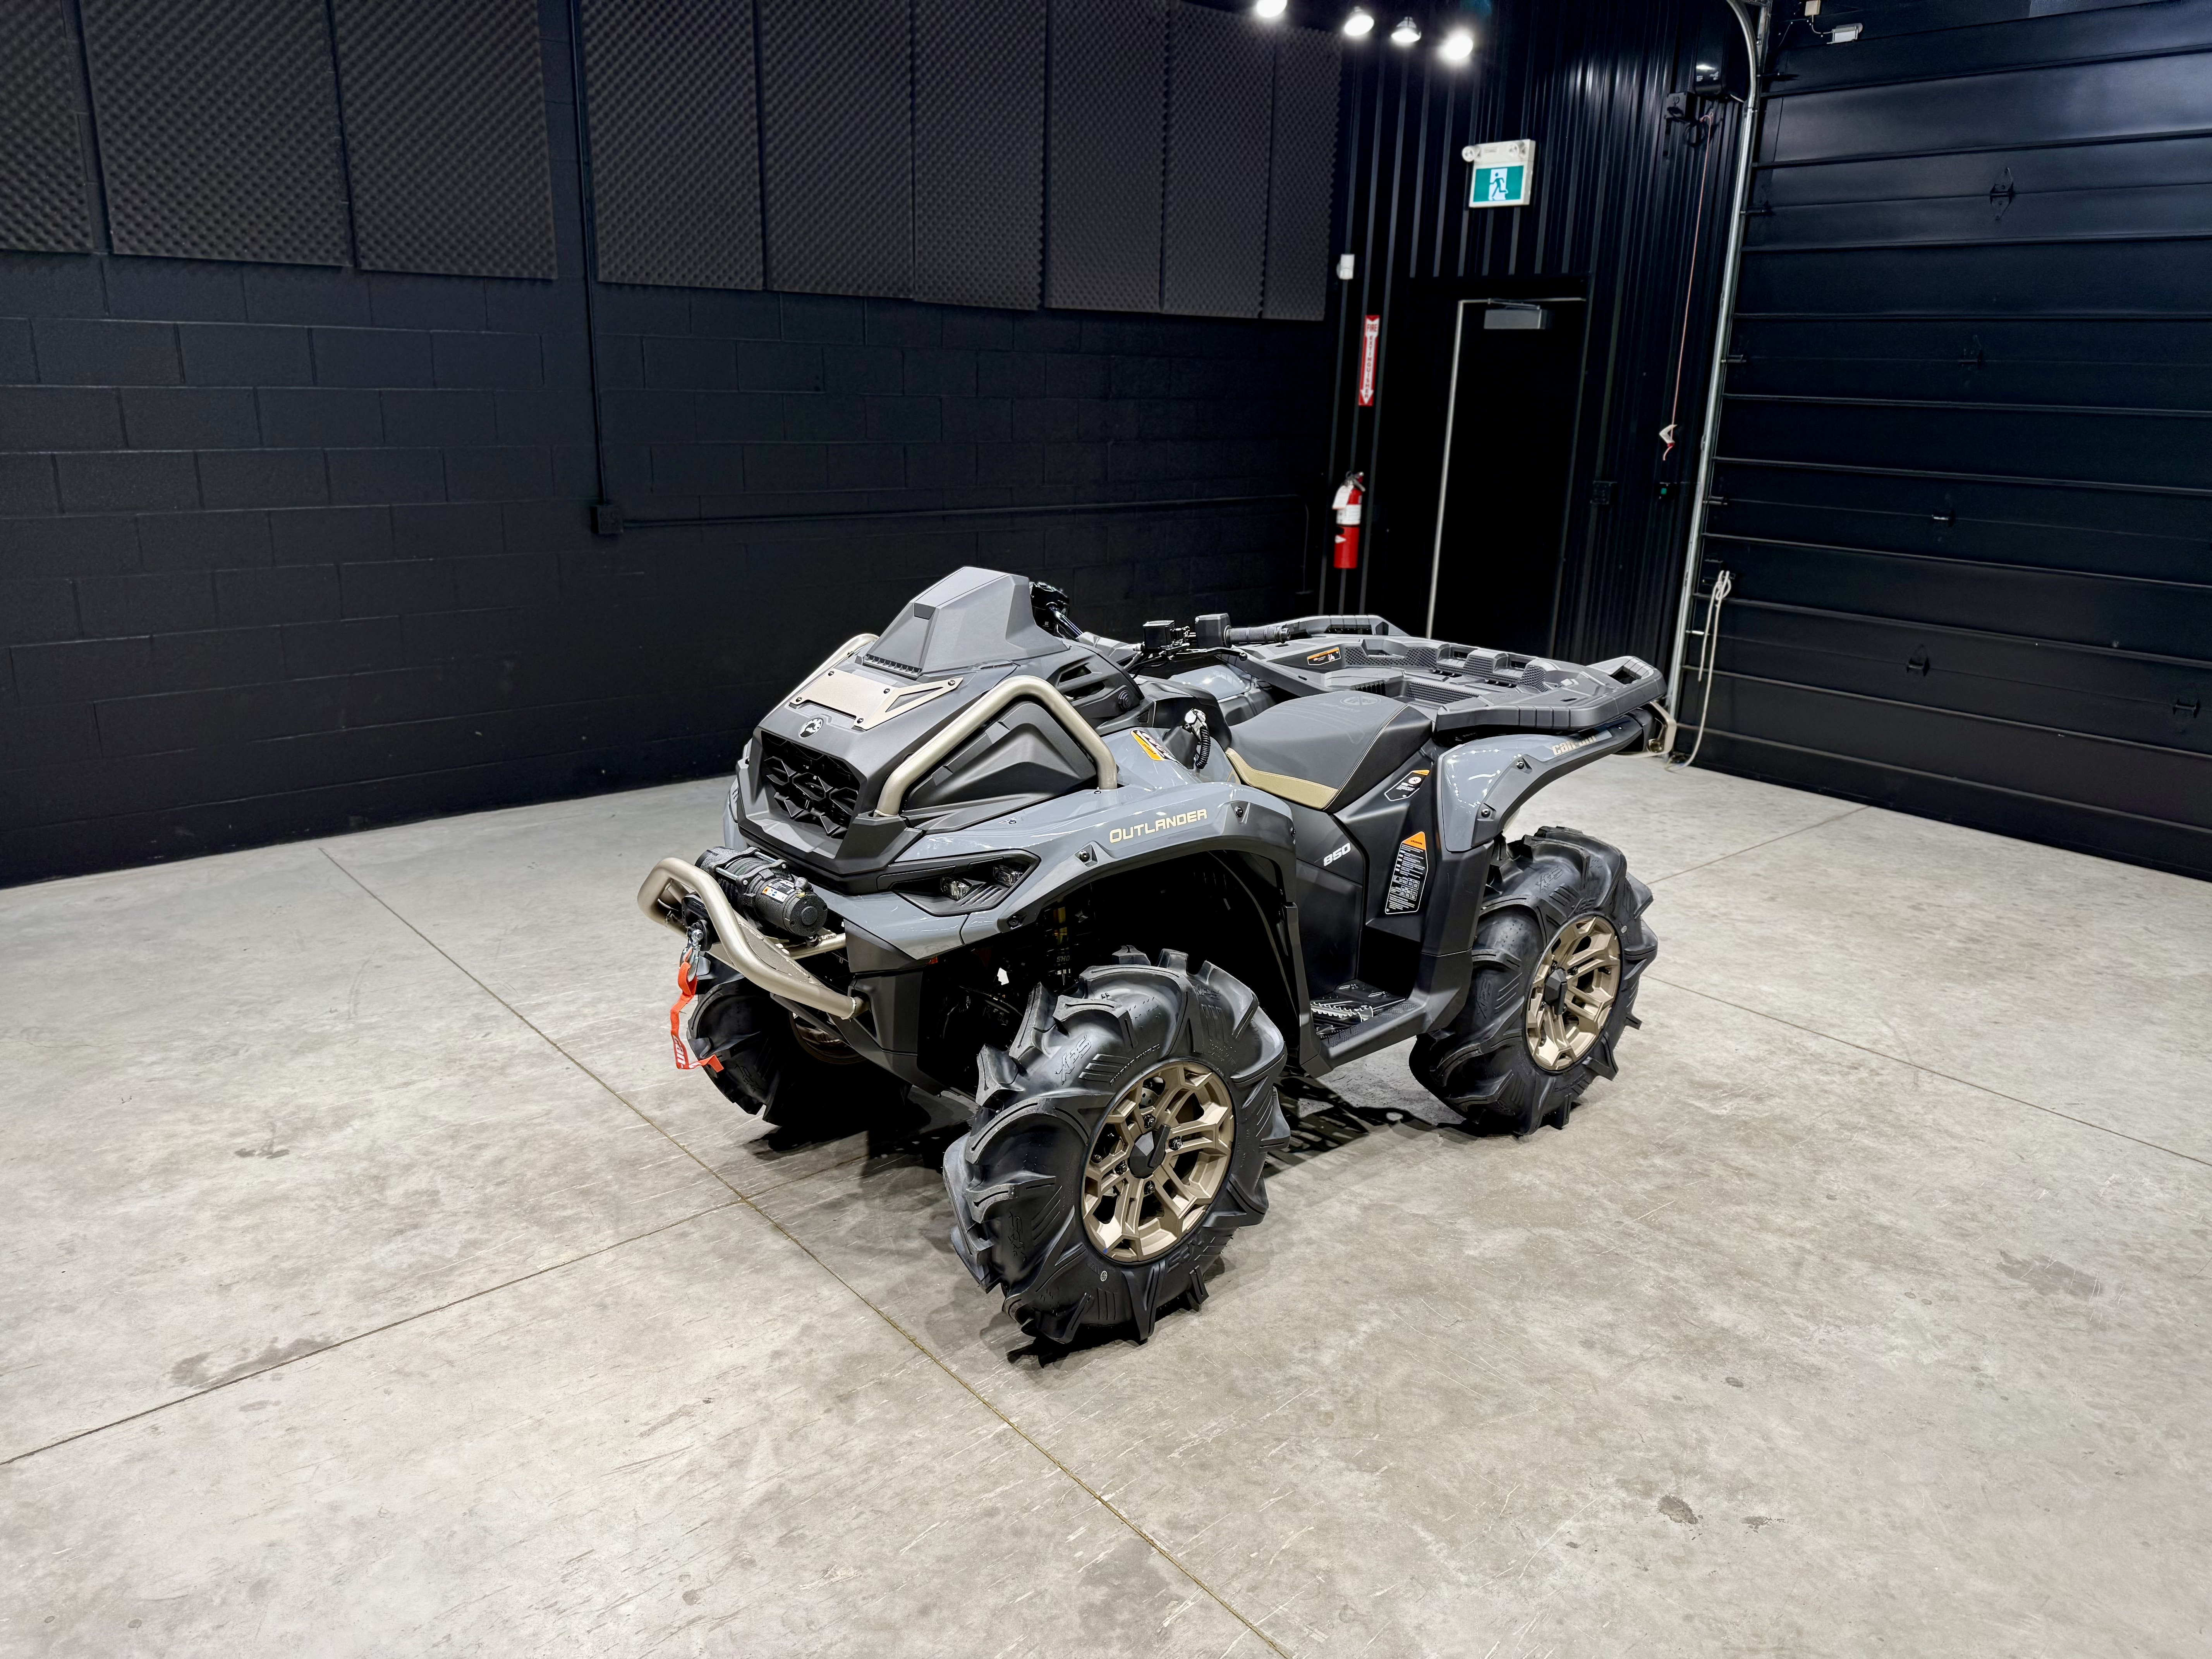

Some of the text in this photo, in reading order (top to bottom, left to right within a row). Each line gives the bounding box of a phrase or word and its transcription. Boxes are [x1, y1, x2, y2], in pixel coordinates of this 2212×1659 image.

[1367, 324, 1378, 332] FIRE
[1365, 335, 1373, 399] EXTINGUISHER
[1109, 809, 1207, 843] OUTLANDER
[1323, 842, 1351, 866] 850
[1054, 1034, 1092, 1085] XPS
